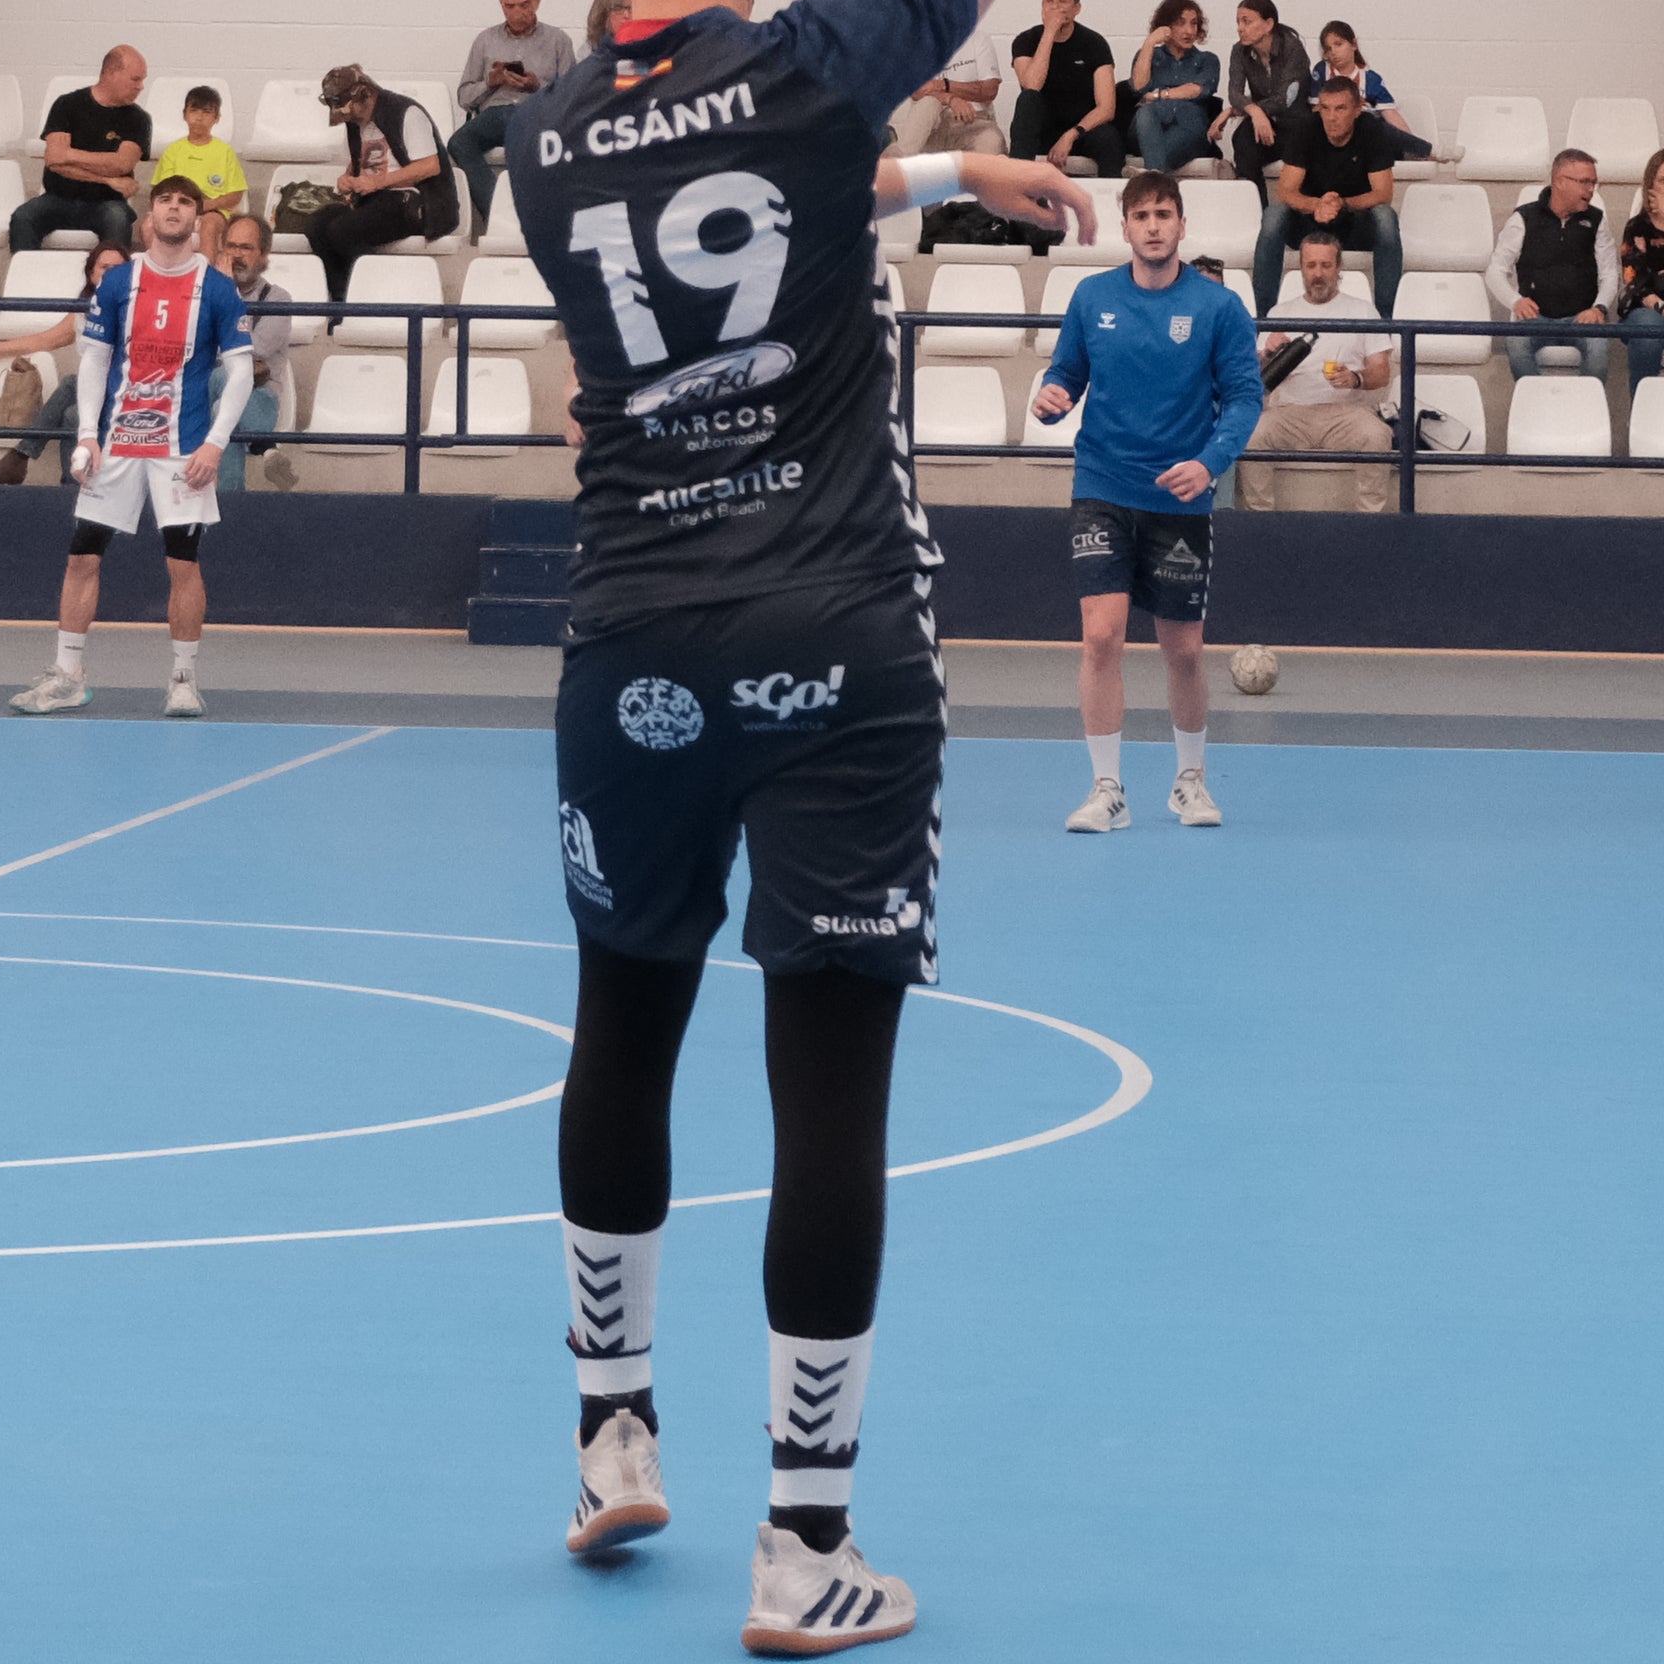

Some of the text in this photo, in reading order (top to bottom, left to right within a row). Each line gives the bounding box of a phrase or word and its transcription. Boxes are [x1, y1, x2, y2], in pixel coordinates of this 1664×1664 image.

[540, 82, 757, 167] D. CSÁNYI
[568, 171, 793, 366] 19
[154, 299, 170, 330] 5
[642, 404, 777, 439] MARCOS
[110, 432, 170, 445] MOVILSA
[1072, 531, 1111, 549] CRC
[811, 913, 899, 937] suma
